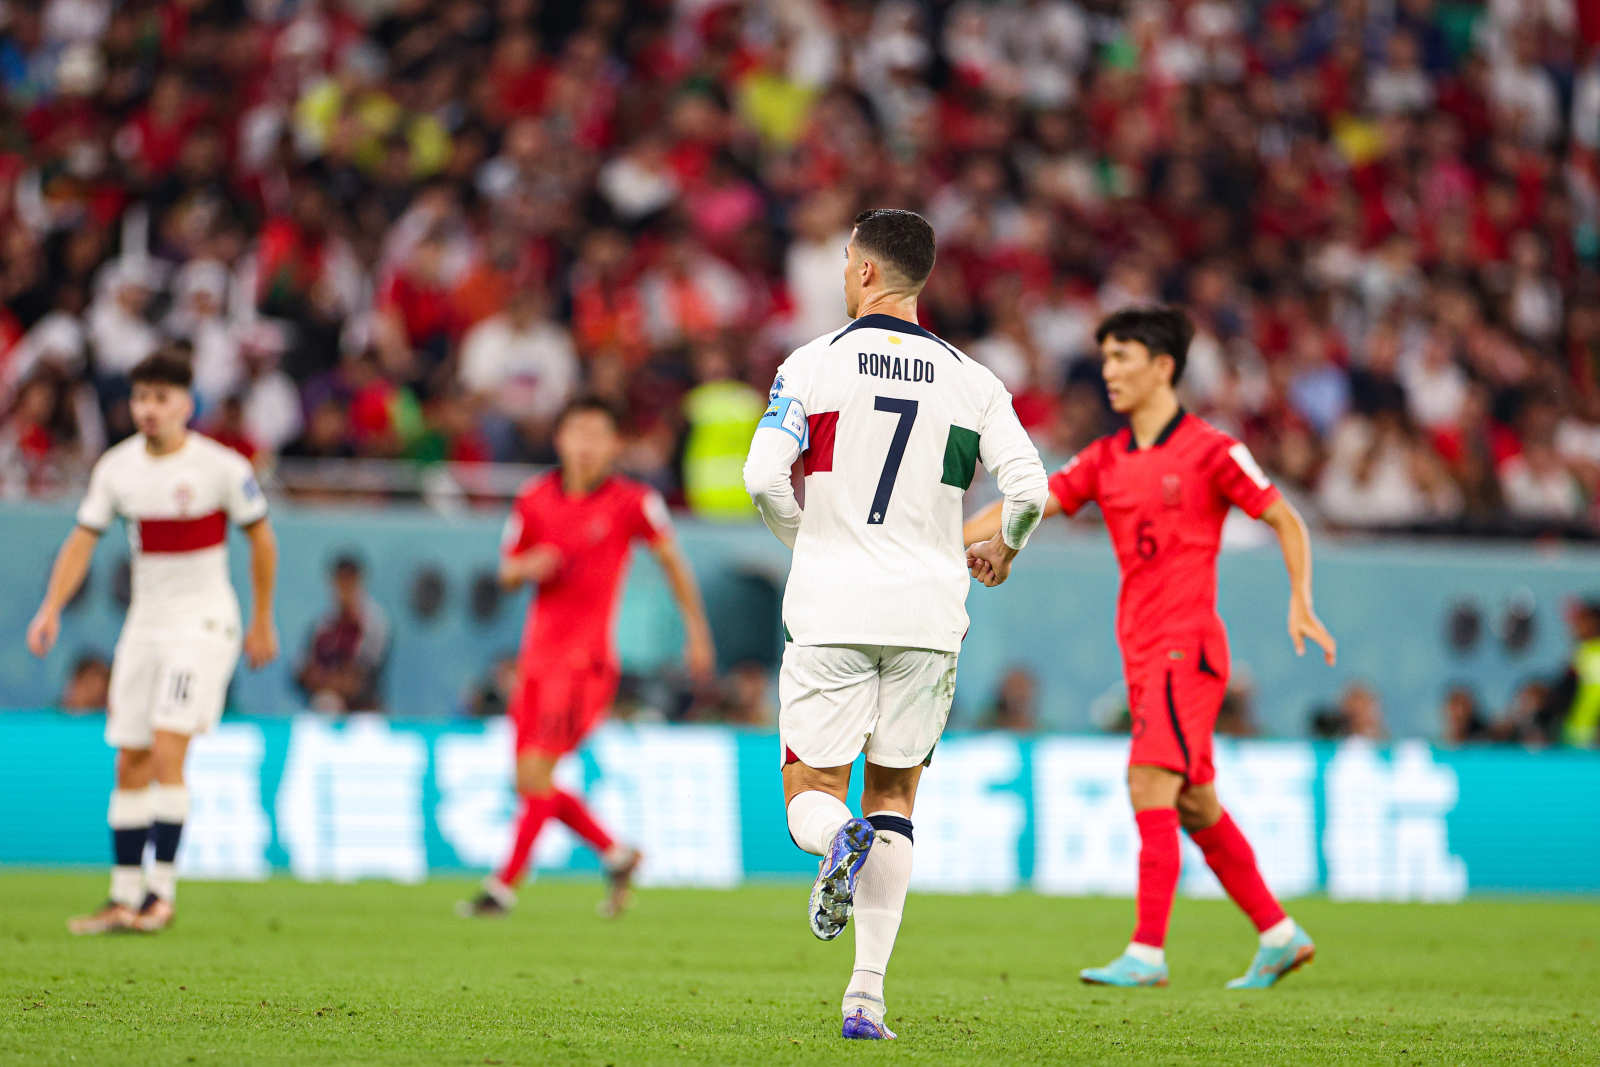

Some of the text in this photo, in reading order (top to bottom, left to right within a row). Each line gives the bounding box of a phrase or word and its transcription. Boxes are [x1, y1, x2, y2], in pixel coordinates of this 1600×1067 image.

[858, 352, 935, 383] RONALDO
[867, 395, 919, 525] 7
[1136, 520, 1157, 561] 6
